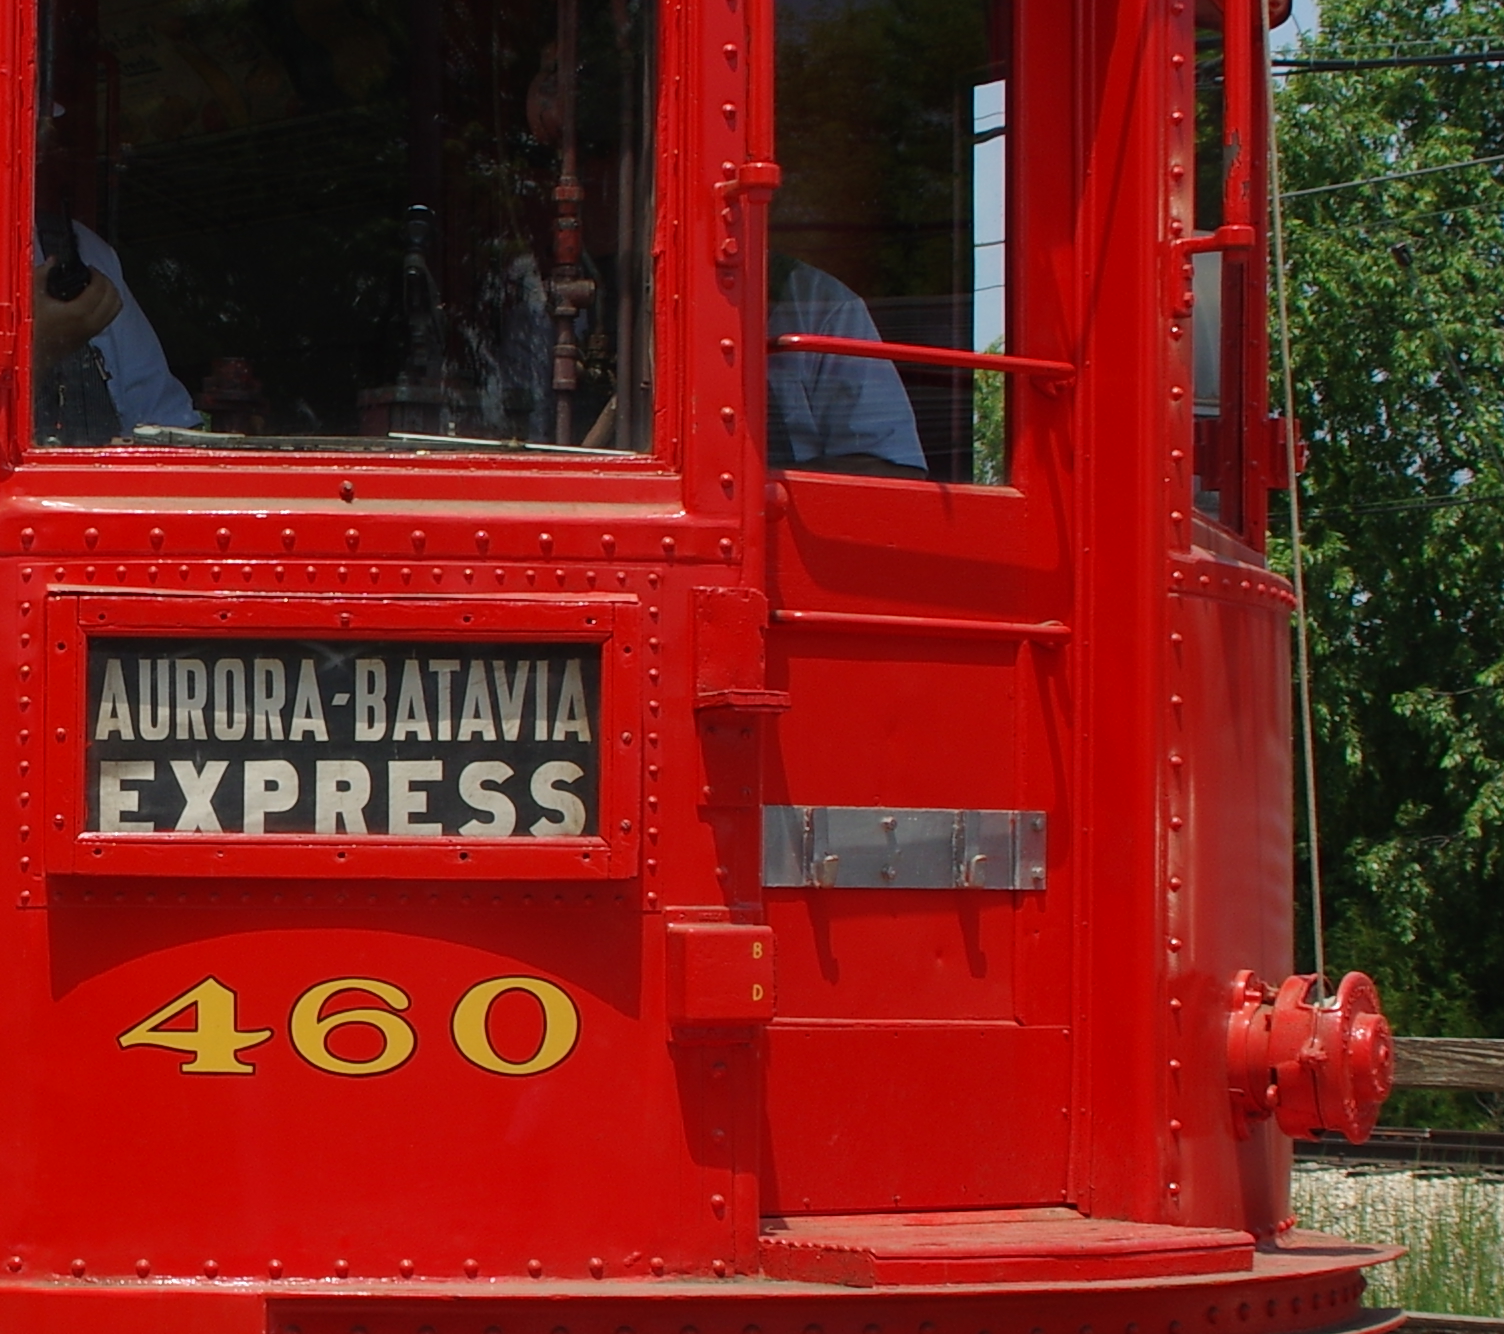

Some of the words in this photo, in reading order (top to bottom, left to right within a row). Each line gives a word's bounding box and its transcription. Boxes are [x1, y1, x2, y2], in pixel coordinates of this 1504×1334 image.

[94, 657, 591, 742] AURORA-BATAVIA
[99, 760, 587, 836] EXPRESS
[752, 941, 763, 959] B
[117, 975, 581, 1076] 460
[752, 983, 764, 1001] D
